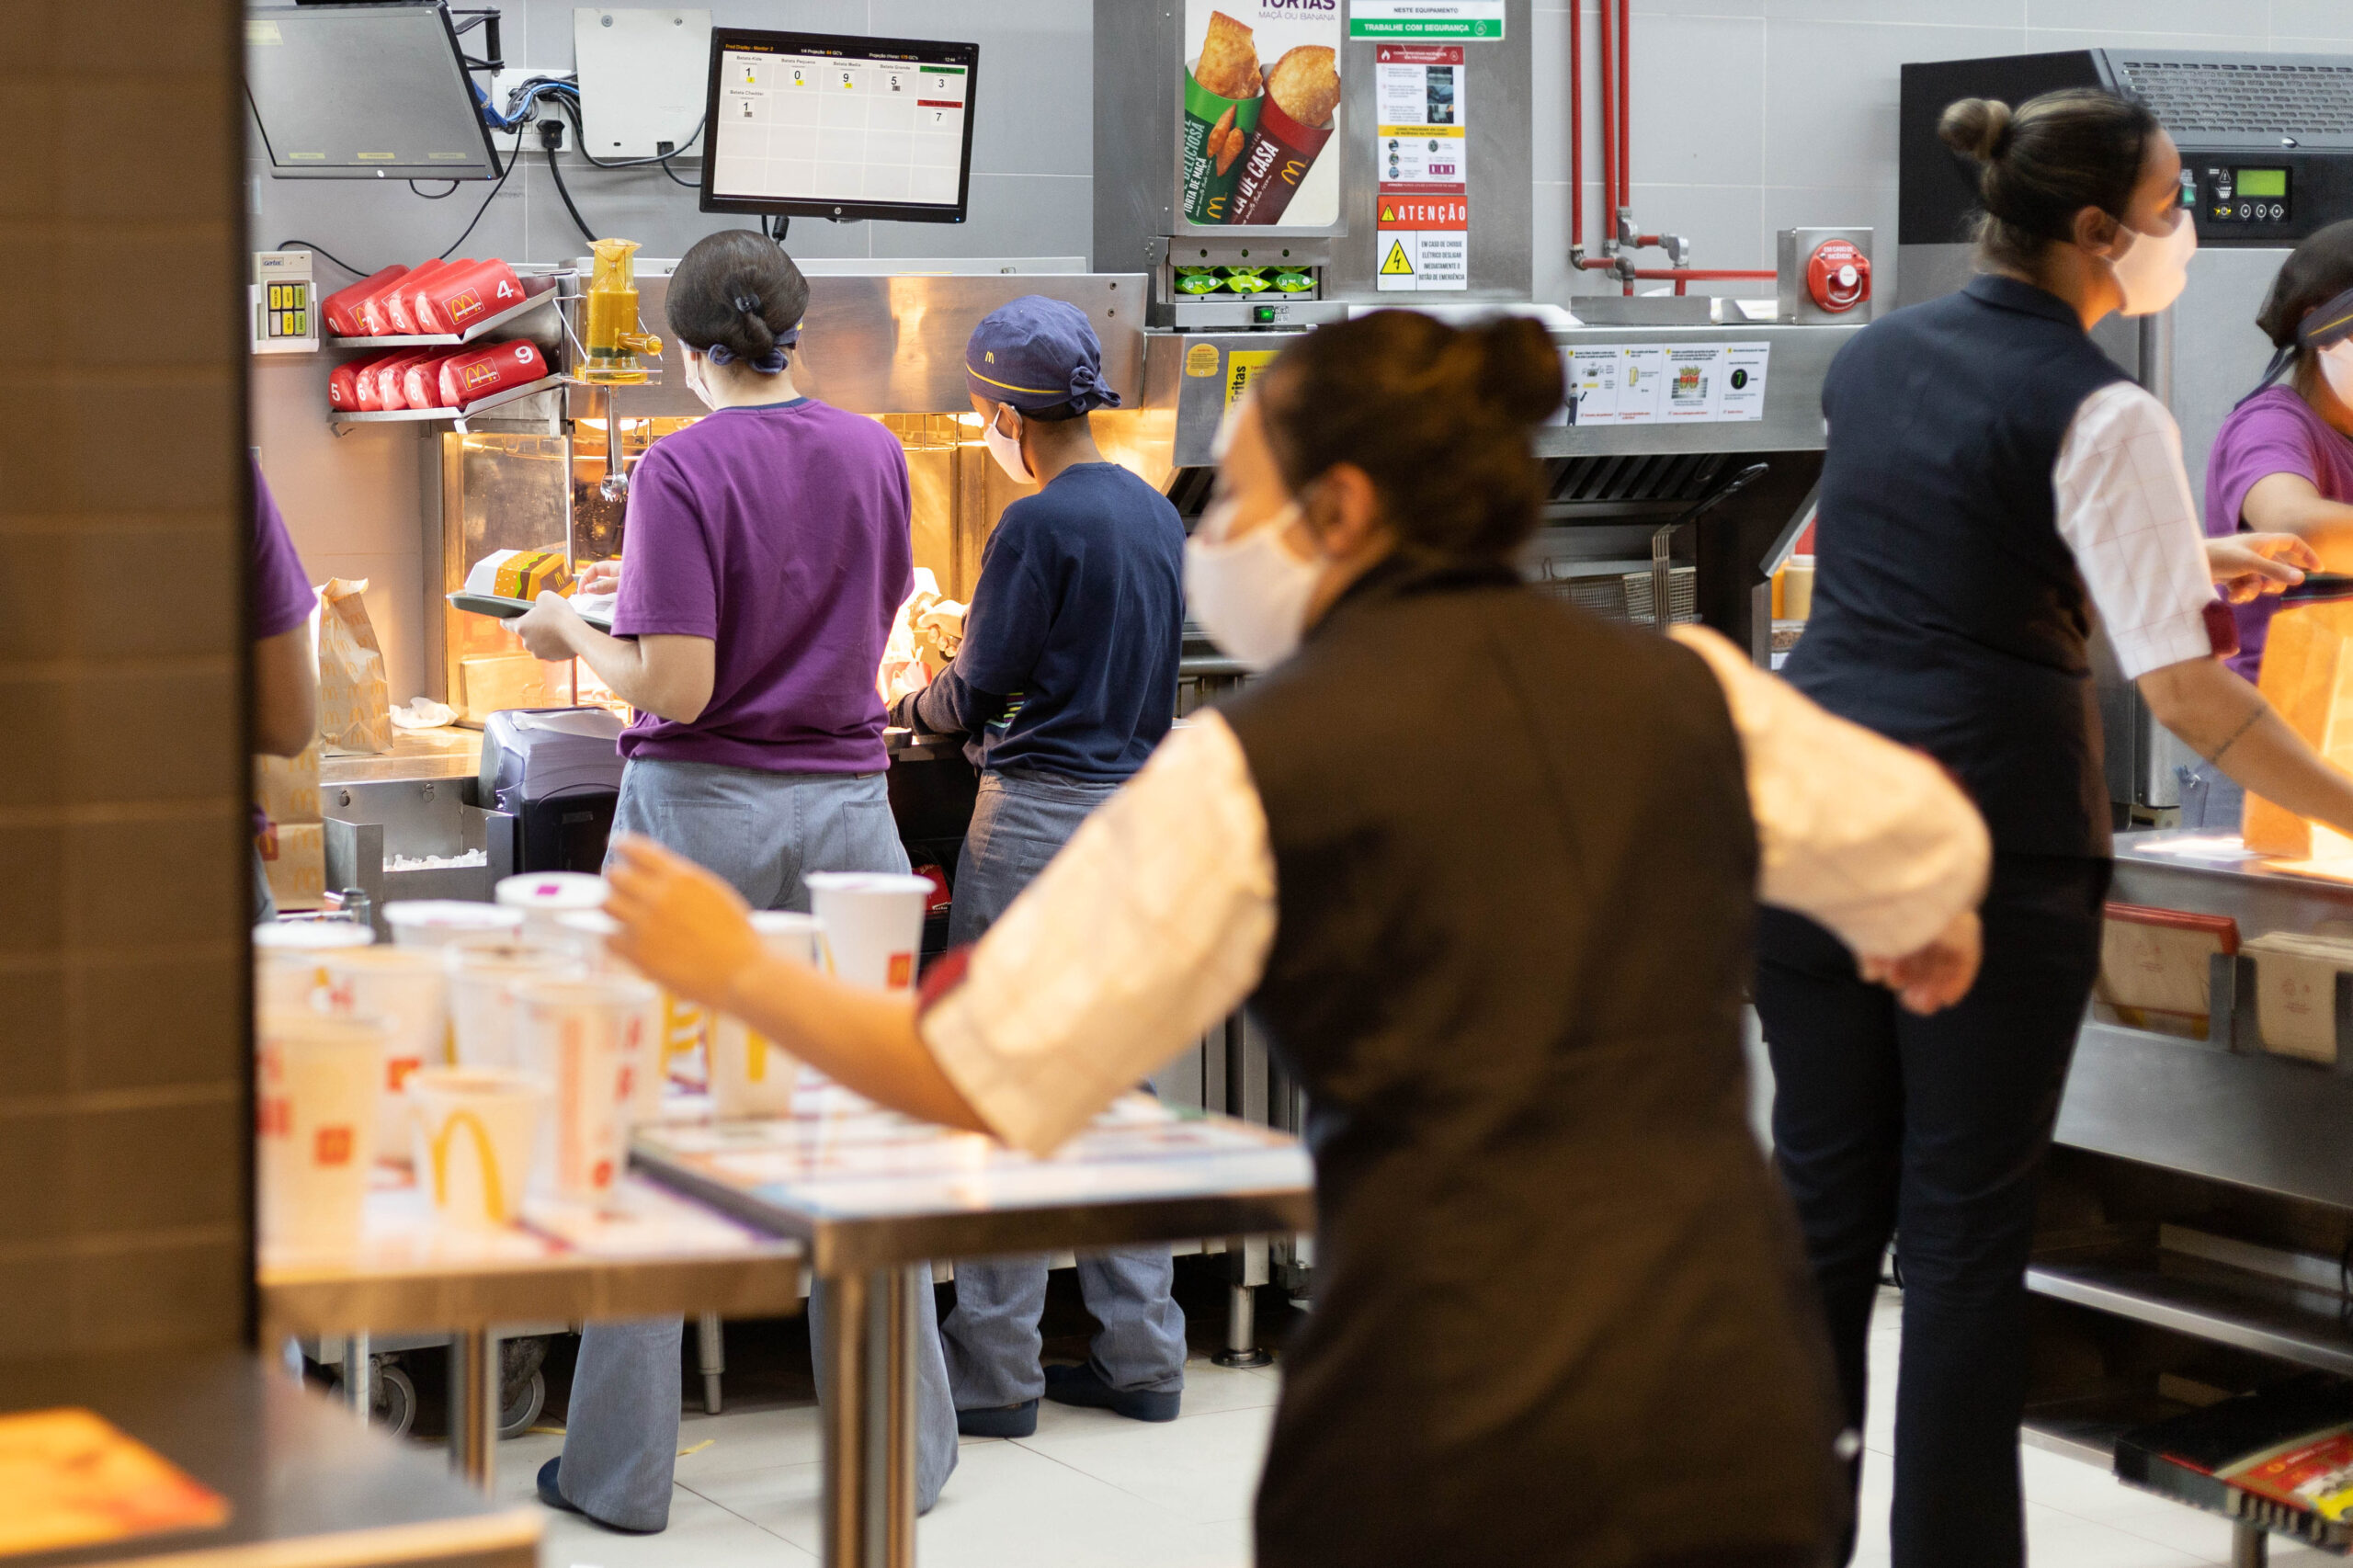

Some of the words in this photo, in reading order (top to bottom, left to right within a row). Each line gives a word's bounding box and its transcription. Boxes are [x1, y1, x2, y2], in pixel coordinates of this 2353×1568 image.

[1425, 24, 1469, 33] SEGURANÇA
[746, 68, 750, 76] 1
[795, 71, 800, 79] 0
[843, 74, 848, 82] 9
[892, 76, 896, 85] 5
[938, 79, 944, 87] 3
[937, 113, 941, 121] 7
[1184, 121, 1205, 181] DELICIOSA
[1246, 140, 1279, 178] CASA
[1193, 157, 1206, 180] MAÇÃ
[1189, 178, 1199, 190] DE
[1184, 191, 1195, 212] TORTA
[1398, 203, 1465, 223] ATENÇÃO
[497, 280, 514, 299] 4
[368, 316, 380, 333] 2
[393, 312, 405, 328] 3
[420, 310, 430, 325] 4
[515, 346, 533, 364] 9
[331, 383, 340, 402] 5
[357, 383, 366, 401] 6
[410, 384, 418, 401] 8
[439, 375, 445, 394] 9
[1231, 366, 1246, 403] Fritas
[380, 384, 389, 403] 7
